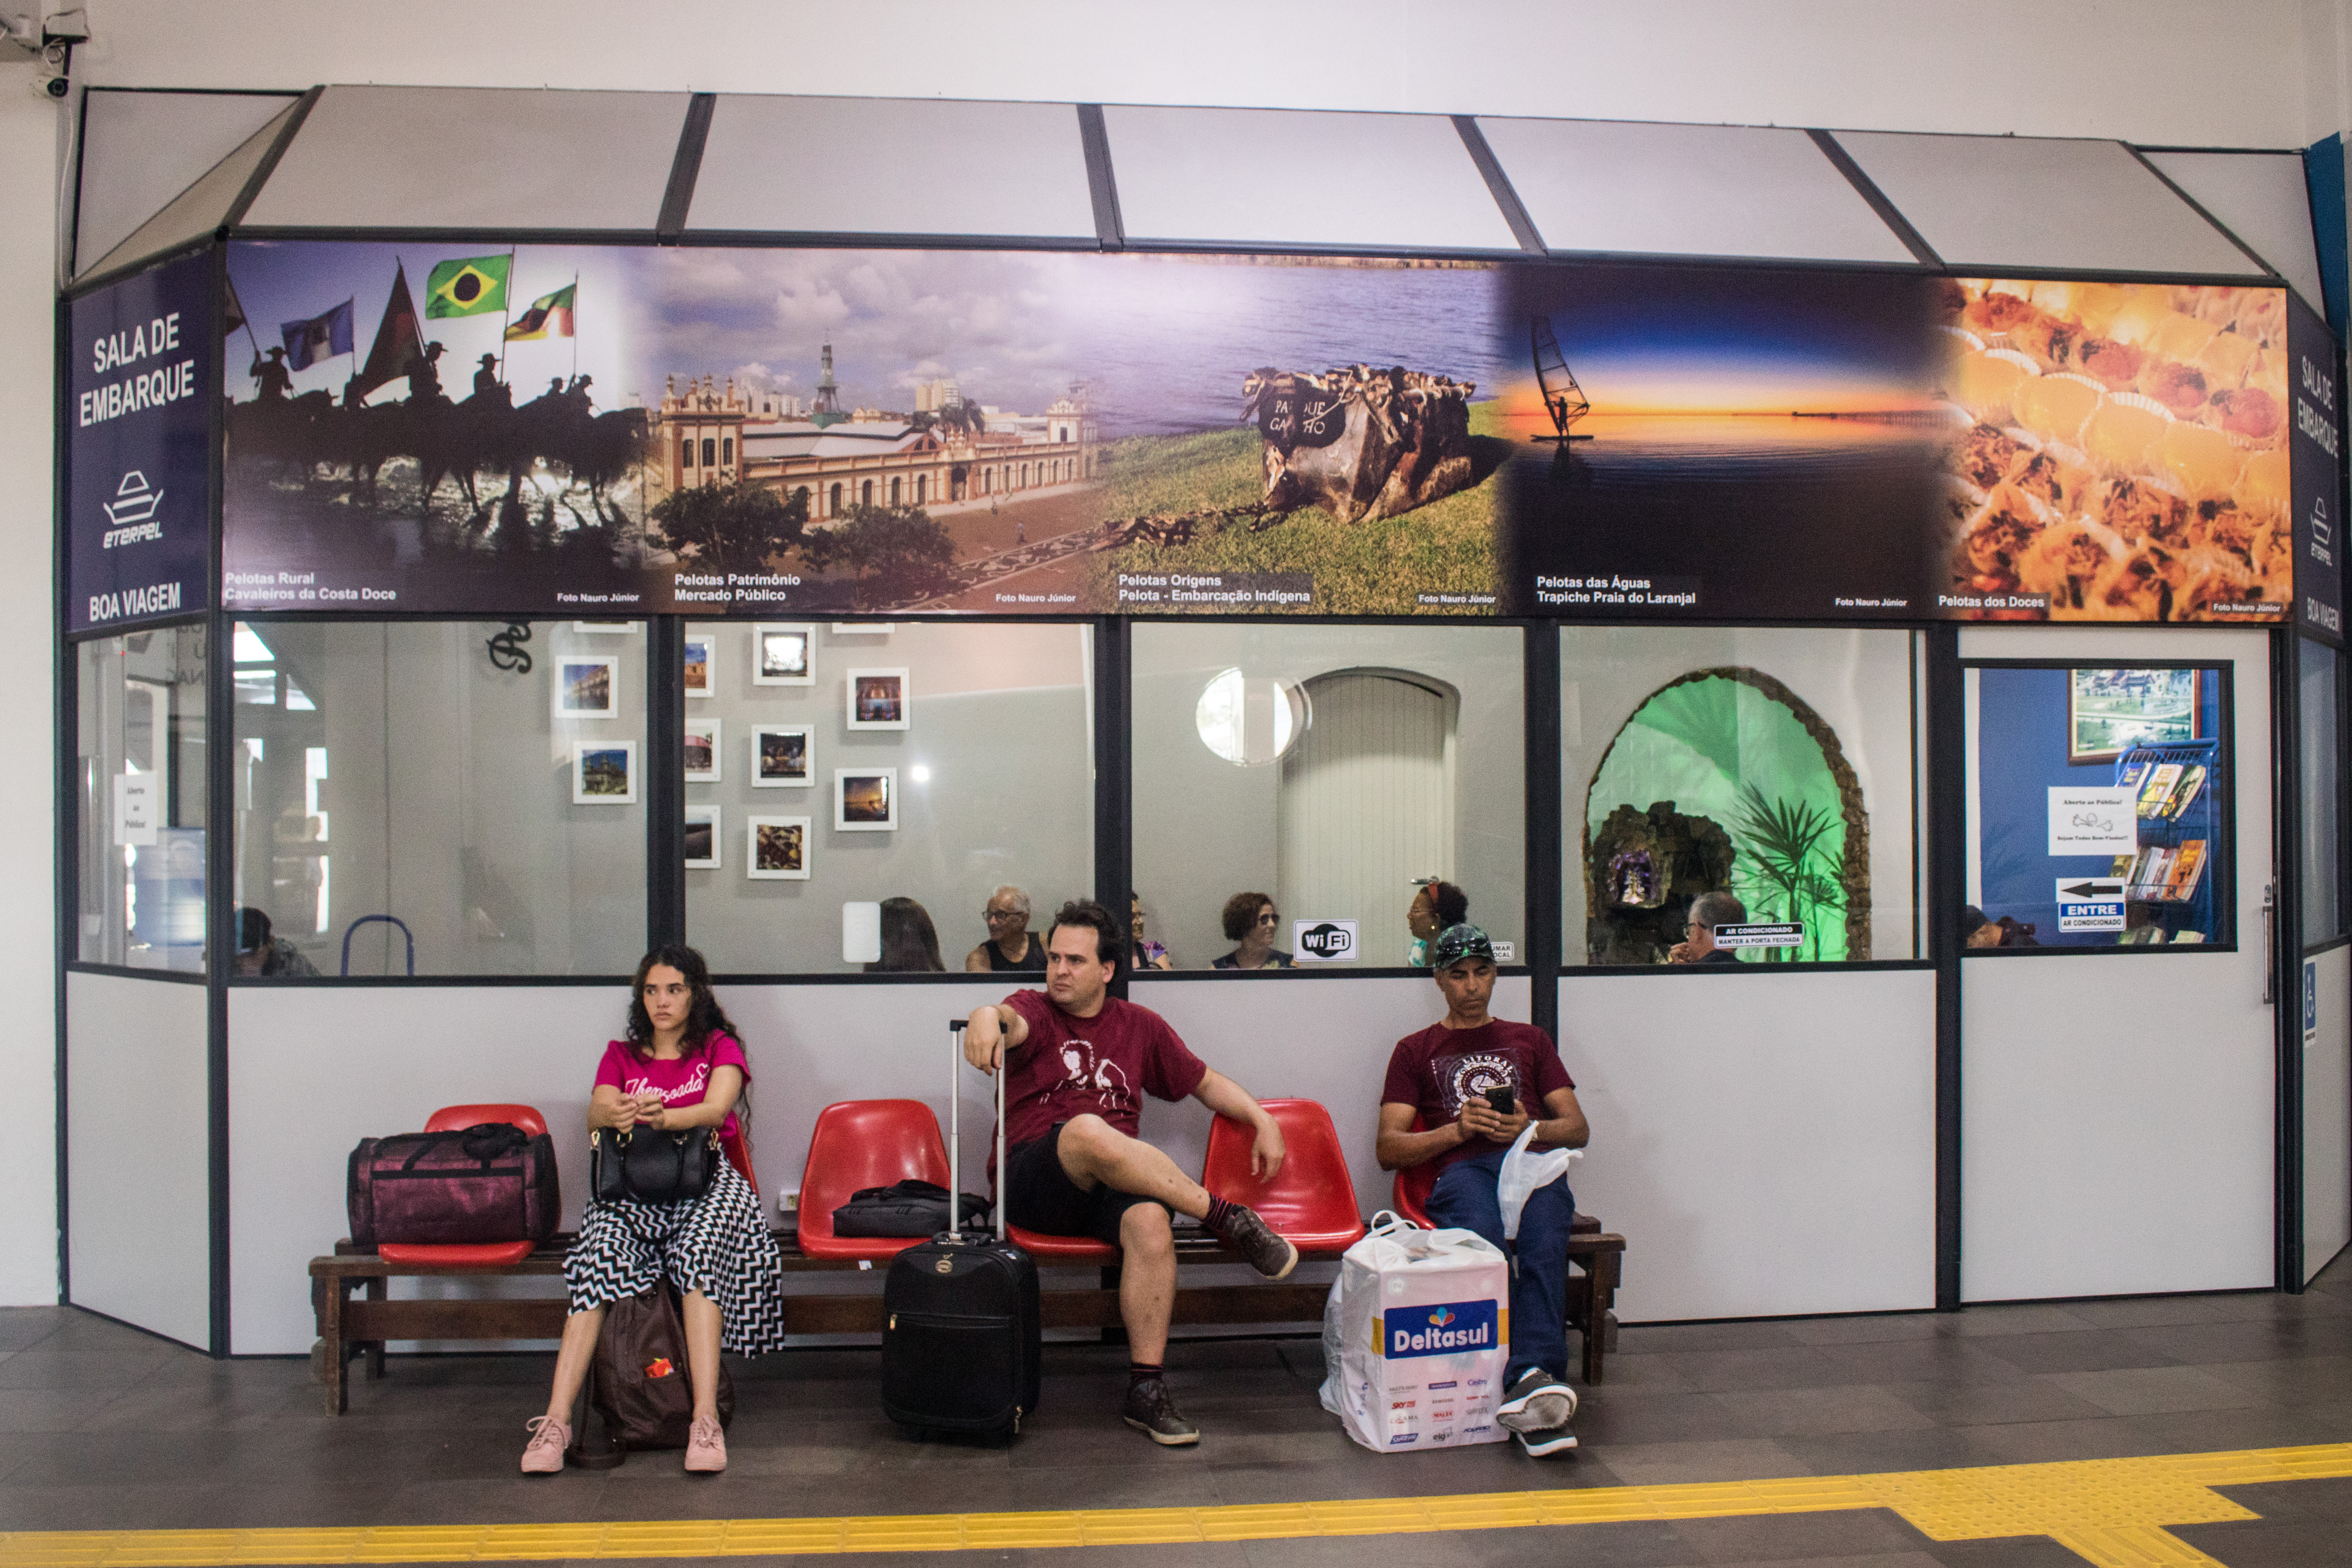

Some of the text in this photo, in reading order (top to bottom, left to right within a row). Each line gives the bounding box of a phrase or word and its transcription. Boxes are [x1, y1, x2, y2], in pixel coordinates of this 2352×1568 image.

[93, 312, 179, 374] SALA DE
[2302, 355, 2332, 411] SALA DE
[80, 359, 194, 427] EMBARQUE
[2298, 397, 2338, 459] EMBARQUE
[225, 572, 315, 585] Pelotas Rural
[675, 573, 801, 586] Pelotas Patrimônio
[1119, 574, 1221, 588] Pelotas Origens
[1536, 574, 1651, 591] Pelotas das Águas
[225, 587, 397, 600] Cavaleiros da Costa Doce
[557, 593, 578, 602] Foto
[580, 593, 608, 602] Nauro
[675, 588, 786, 601] Mercado Público
[996, 593, 1076, 602] Foto Nauro Júnior
[1119, 589, 1159, 601] Pelota
[1172, 589, 1252, 604] Embarcação
[1255, 590, 1310, 604] Indígena
[1418, 594, 1496, 603] Foto Nauro Júnior
[1536, 591, 1696, 606] Trapiche Praia do Laranjal
[89, 582, 180, 622] BOA VIAGEM
[1835, 597, 1854, 606] Foto
[1855, 598, 1880, 607] Nauro
[1938, 595, 2045, 608] Pelotas dos Doces
[2213, 602, 2231, 611] Foto
[2232, 603, 2256, 611] Nauro
[2068, 904, 2118, 916] ENTRE
[1737, 926, 1793, 935] CONDICIONADO
[1463, 1055, 1514, 1073] LITORAL
[1394, 1321, 1488, 1352] Deltasul
